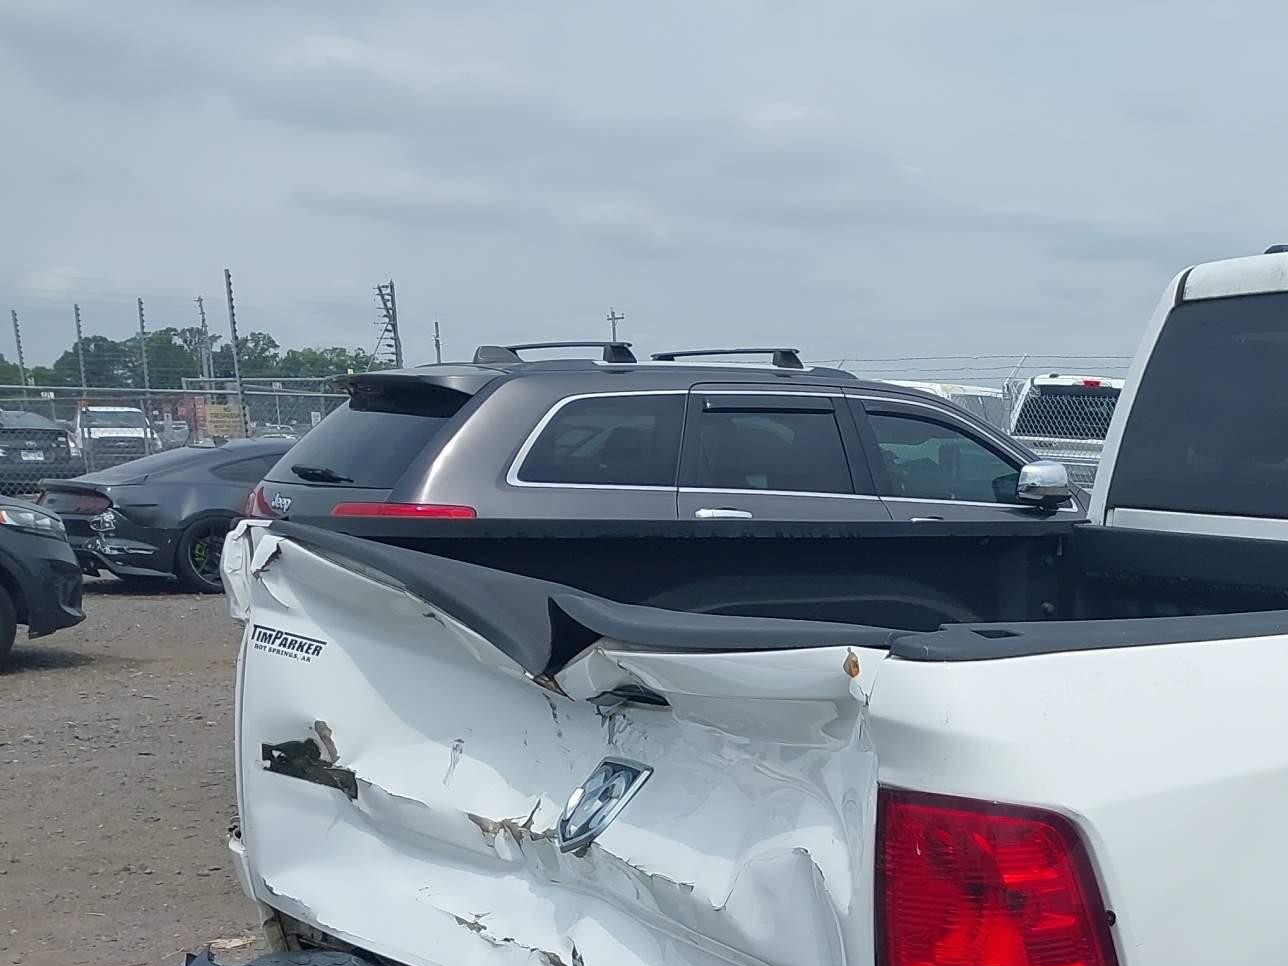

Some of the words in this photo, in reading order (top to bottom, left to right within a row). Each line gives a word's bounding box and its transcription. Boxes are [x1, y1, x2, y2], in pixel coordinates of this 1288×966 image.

[271, 493, 292, 513] Jeep
[254, 643, 267, 652] HOT
[268, 646, 299, 661] SPRINGS,
[301, 655, 312, 663] AR
